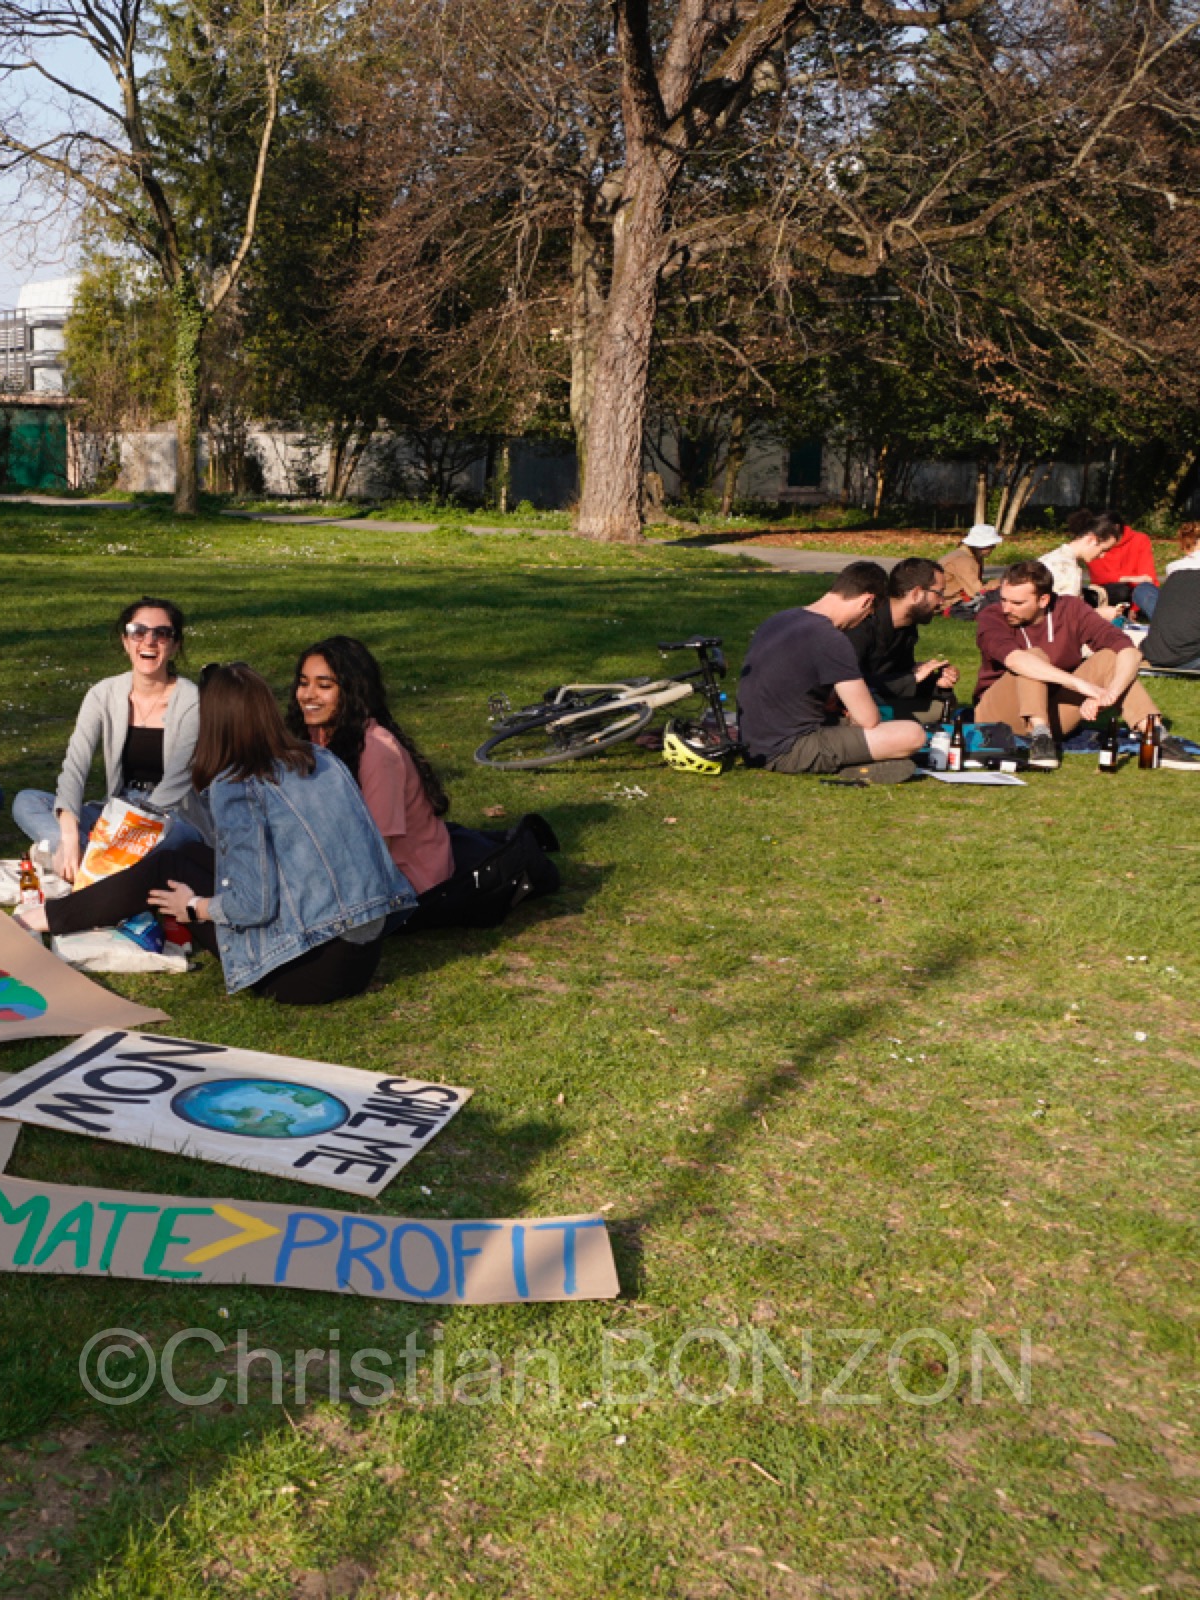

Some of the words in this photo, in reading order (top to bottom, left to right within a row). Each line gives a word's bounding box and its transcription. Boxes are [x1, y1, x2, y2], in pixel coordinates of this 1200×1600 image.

[36, 1036, 227, 1132] NOW
[347, 1079, 459, 1139] SAVE
[293, 1130, 413, 1184] ME
[273, 1211, 605, 1299] PROFIT
